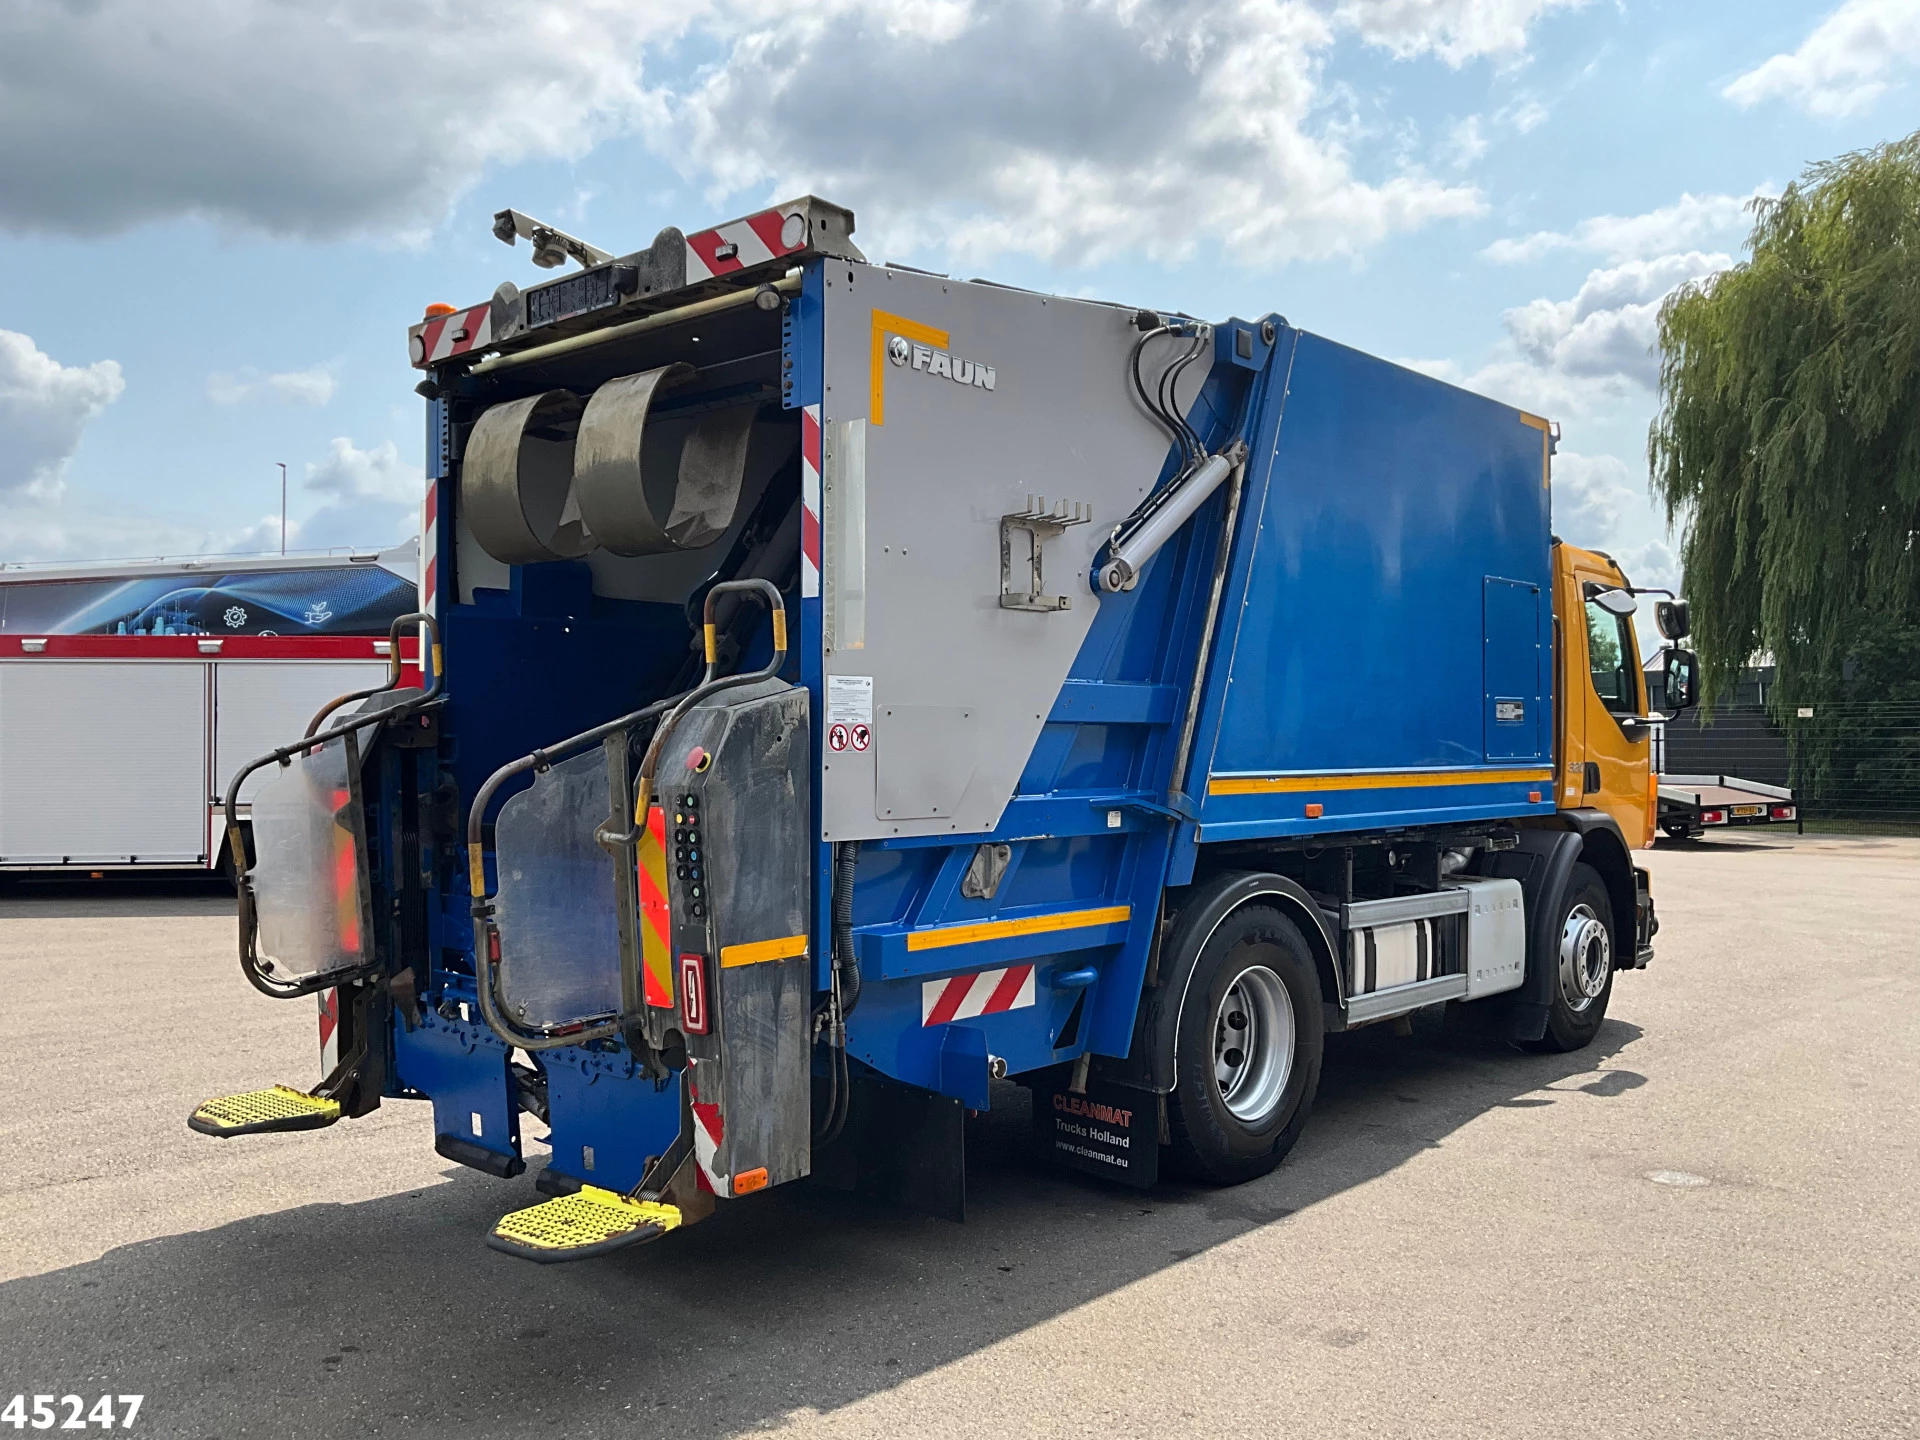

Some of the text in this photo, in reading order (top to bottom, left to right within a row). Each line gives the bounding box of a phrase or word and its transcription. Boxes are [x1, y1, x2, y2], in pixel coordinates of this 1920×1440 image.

[912, 344, 996, 391] FAUN
[1052, 1094, 1133, 1128] CLEANMAT
[1055, 1118, 1130, 1148] Trucks Holland
[1055, 1140, 1128, 1168] www.cleanmat.eu
